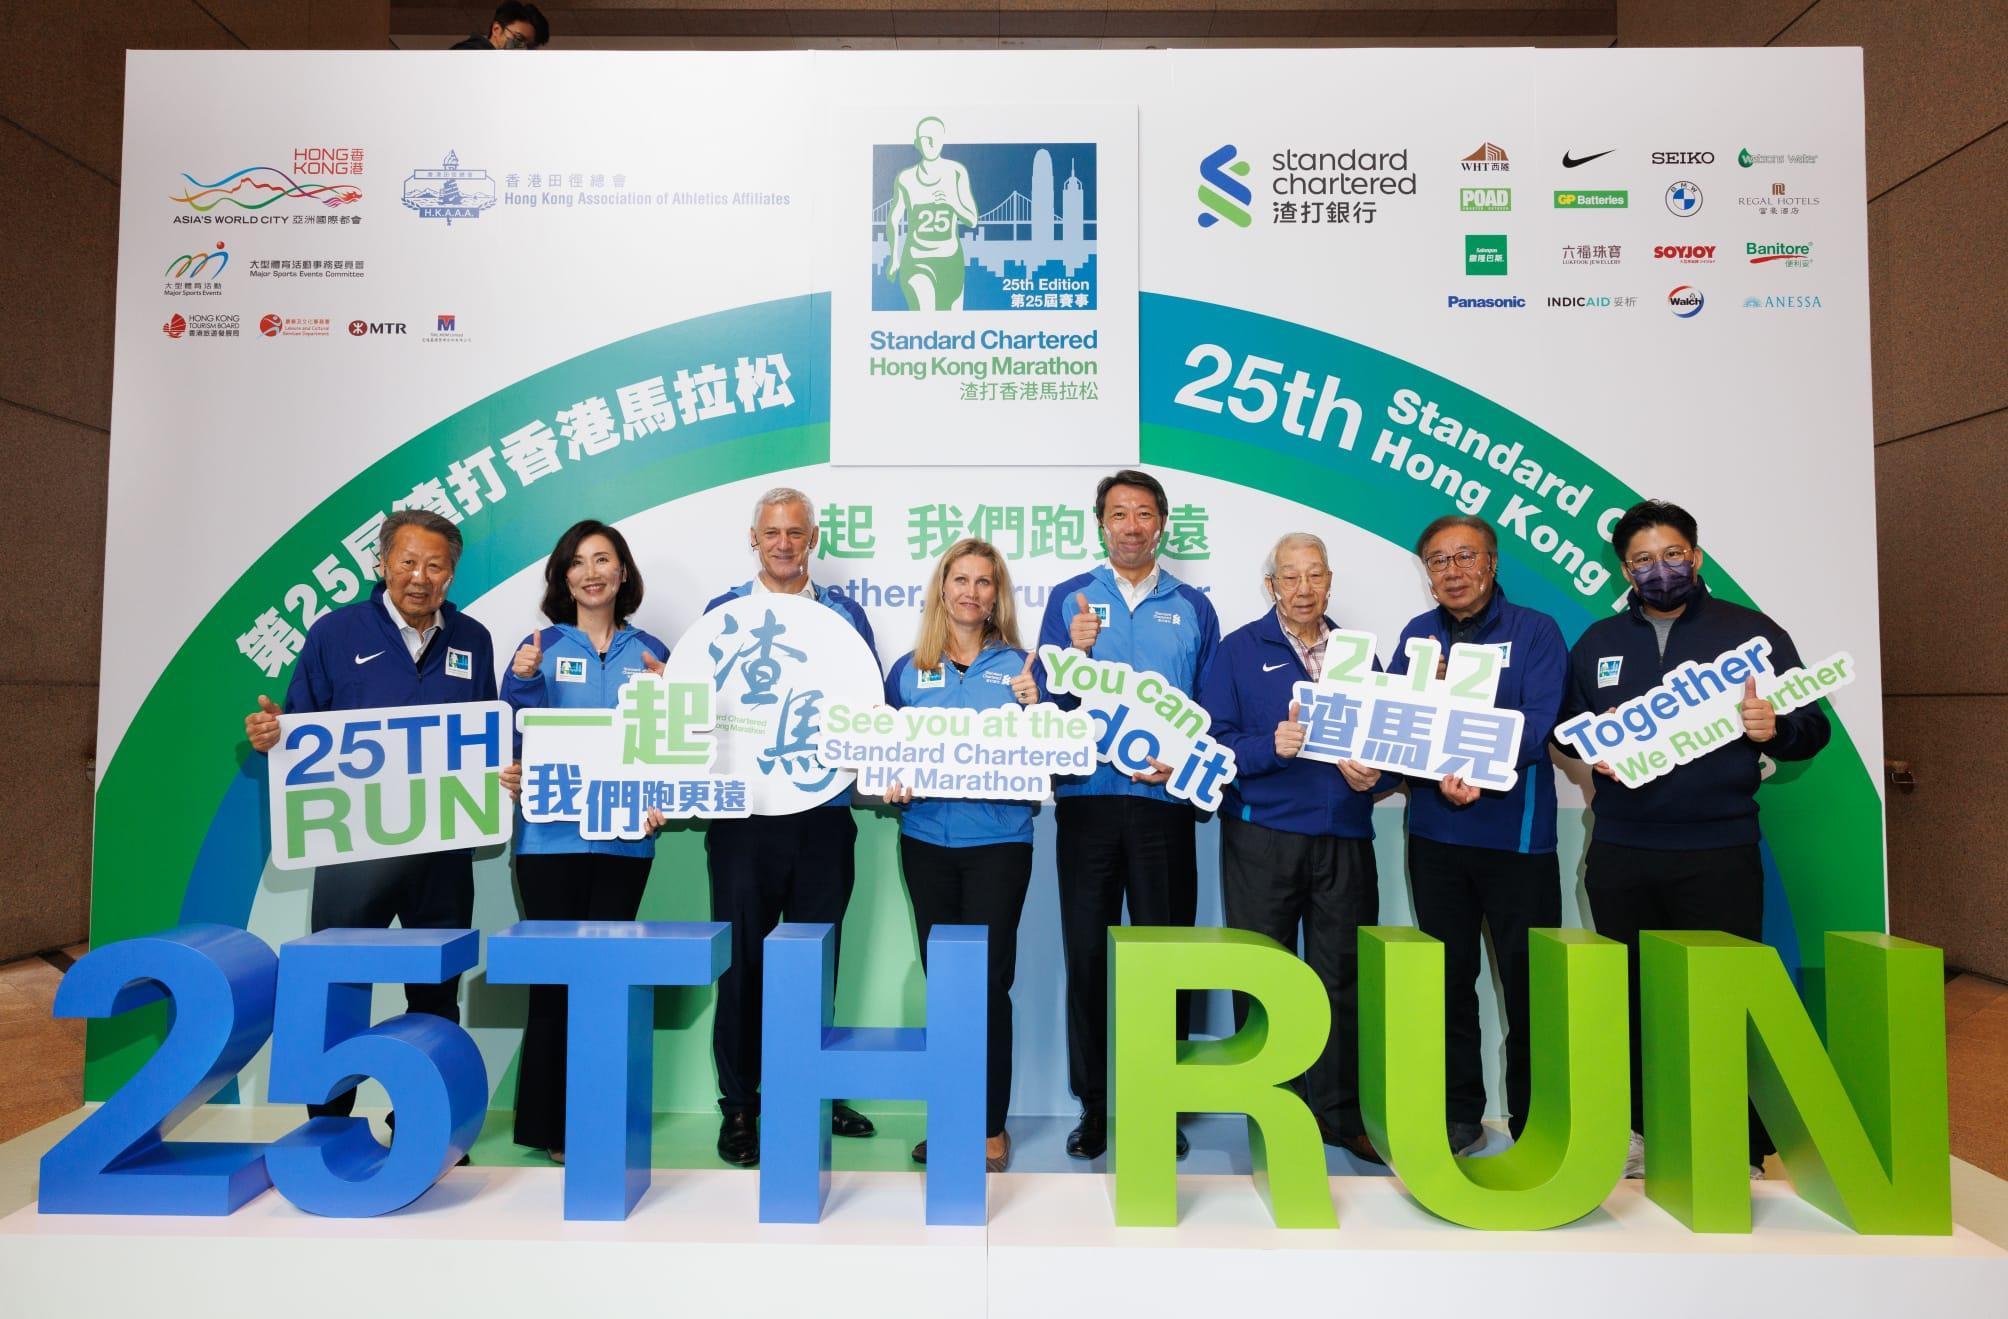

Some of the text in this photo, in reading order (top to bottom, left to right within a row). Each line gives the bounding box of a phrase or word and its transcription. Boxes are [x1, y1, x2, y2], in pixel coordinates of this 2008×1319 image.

[294, 148, 349, 161] HONG
[1272, 148, 1408, 171] standard
[1651, 151, 1715, 165] SEIKO
[294, 162, 349, 175] KONG
[1461, 162, 1490, 172] WHT
[505, 173, 628, 189] 香港田徑總會
[1272, 172, 1417, 195] chartered
[504, 192, 791, 208] Hong Kong Association of Athletics Affiliates
[1462, 189, 1509, 207] POAD
[1557, 194, 1624, 205] GP Batteries
[1738, 197, 1820, 206] REGAL HOTELS
[173, 215, 289, 225] ASIA'S WORLD CITY
[292, 215, 362, 225] 亞洲國際都會
[1272, 200, 1377, 224] 渣打銀行
[917, 210, 951, 233] 25
[1562, 244, 1622, 259] 六福珠寶
[1654, 245, 1716, 259] SOYJOY
[1746, 242, 1810, 255] Banitore
[249, 259, 365, 270] 大型體育活動事務委員會
[249, 270, 365, 279] Major Sports Events Committee
[163, 289, 182, 297] Major
[182, 289, 202, 297] Sports
[165, 282, 222, 290] 大型體育活動
[1002, 278, 1089, 291] 25th Edition
[1010, 293, 1089, 308] 第25屆賽事
[1447, 295, 1526, 308] Panasonic
[1547, 296, 1611, 307] INDICAID
[1613, 296, 1637, 308] 妥析
[1670, 297, 1702, 307] Walch
[1765, 296, 1823, 308] ANESSA
[188, 314, 240, 322] HONG KONG
[369, 322, 407, 335] MTR
[870, 330, 1098, 350] Standard Chartered
[869, 356, 1097, 380] Hong Kong Marathon
[960, 380, 1099, 401] 渣打香港馬拉松
[1173, 342, 1363, 452] 25th
[1386, 386, 1587, 517] Standard
[1370, 428, 1491, 515] Hong
[1496, 493, 1613, 592] Kong
[907, 503, 1211, 561] 我們跑遠
[1326, 634, 1496, 700] 2.12
[1047, 652, 1204, 739] You can
[1563, 642, 1772, 758] Together
[523, 679, 710, 765] 一起
[825, 704, 1088, 742] See you at the
[1298, 687, 1517, 784] 渣馬見
[285, 710, 500, 787] 25TH
[824, 739, 1089, 768] Standard Chartered
[1616, 749, 1668, 782] We
[1668, 716, 1735, 758] Run
[865, 767, 1043, 793] HK Marathon
[1173, 740, 1229, 805] it
[528, 762, 747, 833] 我們跑更遠
[284, 771, 500, 860] RUN
[38, 921, 1953, 1236] 25TH RUN
